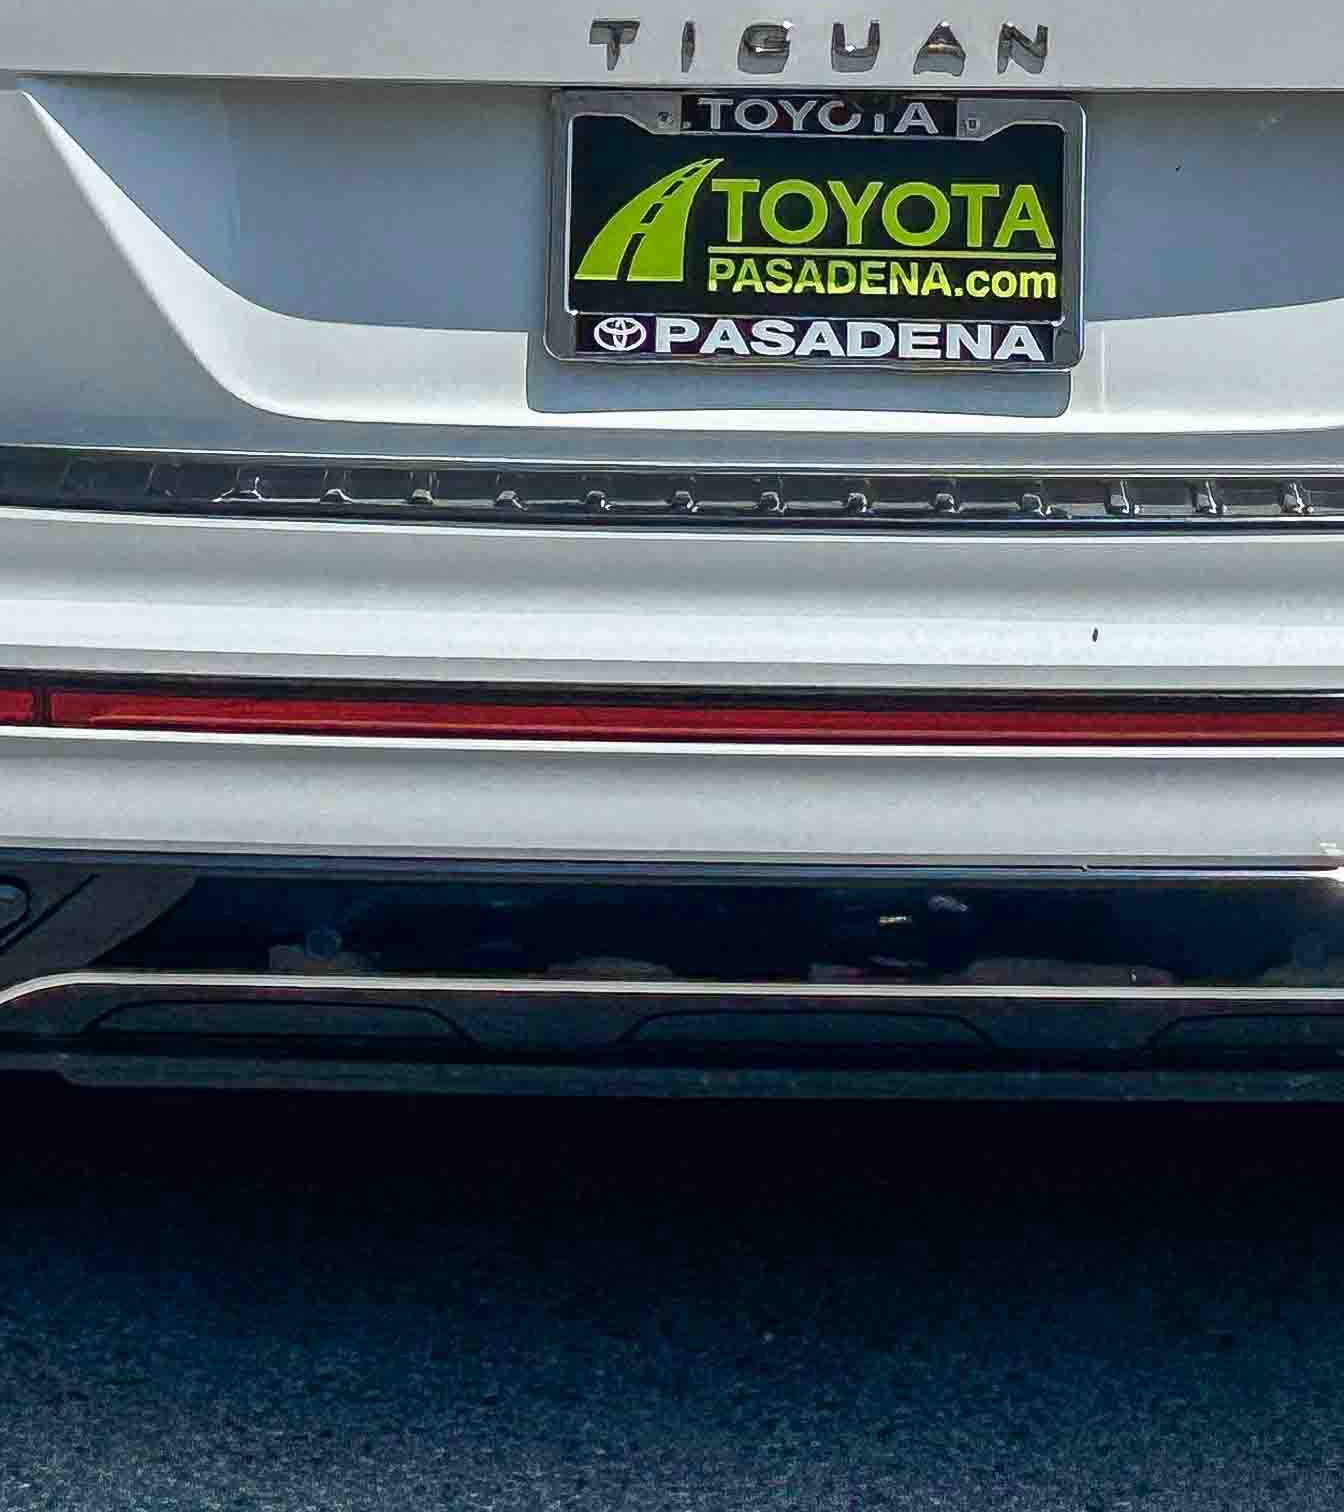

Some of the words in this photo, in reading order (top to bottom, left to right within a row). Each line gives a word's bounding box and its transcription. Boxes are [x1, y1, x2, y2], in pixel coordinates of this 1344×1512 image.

[588, 17, 1049, 77] TIGUAN
[711, 178, 1056, 250] TOYOTA
[707, 256, 1058, 300] PASADENA.com
[655, 317, 1046, 362] PASADENA
